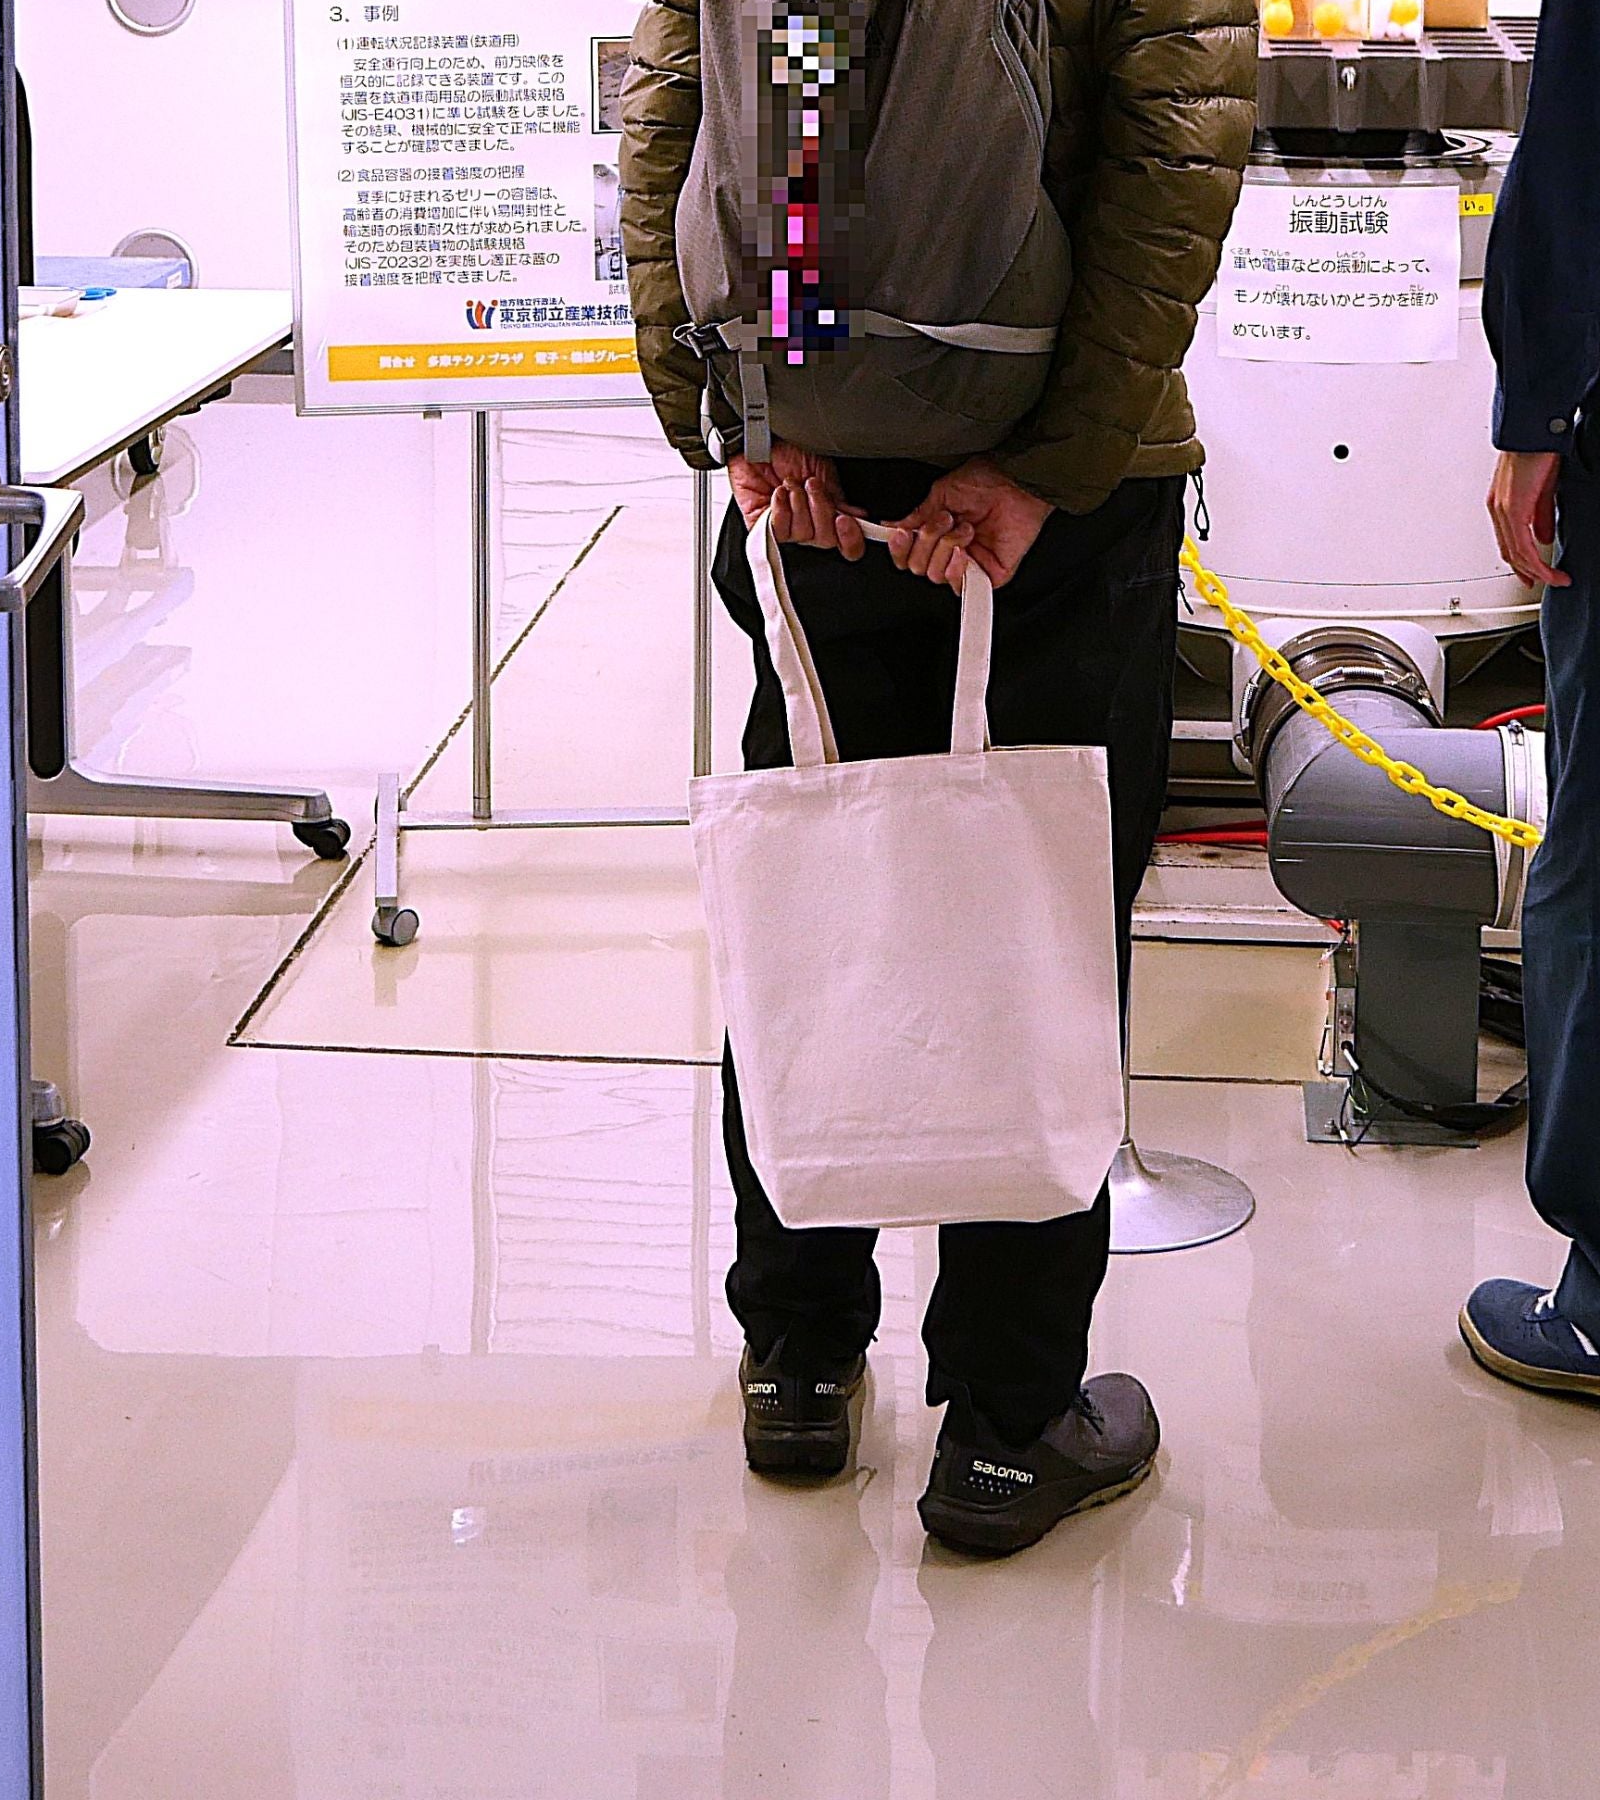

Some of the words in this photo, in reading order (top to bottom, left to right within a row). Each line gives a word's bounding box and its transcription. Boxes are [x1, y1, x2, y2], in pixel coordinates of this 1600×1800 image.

[1293, 195, 1387, 207] しんどうしけん
[1289, 210, 1389, 234] 振動試験
[1234, 257, 1430, 274] 車や電車などの振動によって、
[1234, 289, 1438, 307] モノが壊れないかどうかを確か
[499, 304, 632, 322] 東京都立産業技術
[1233, 323, 1312, 341] めています。
